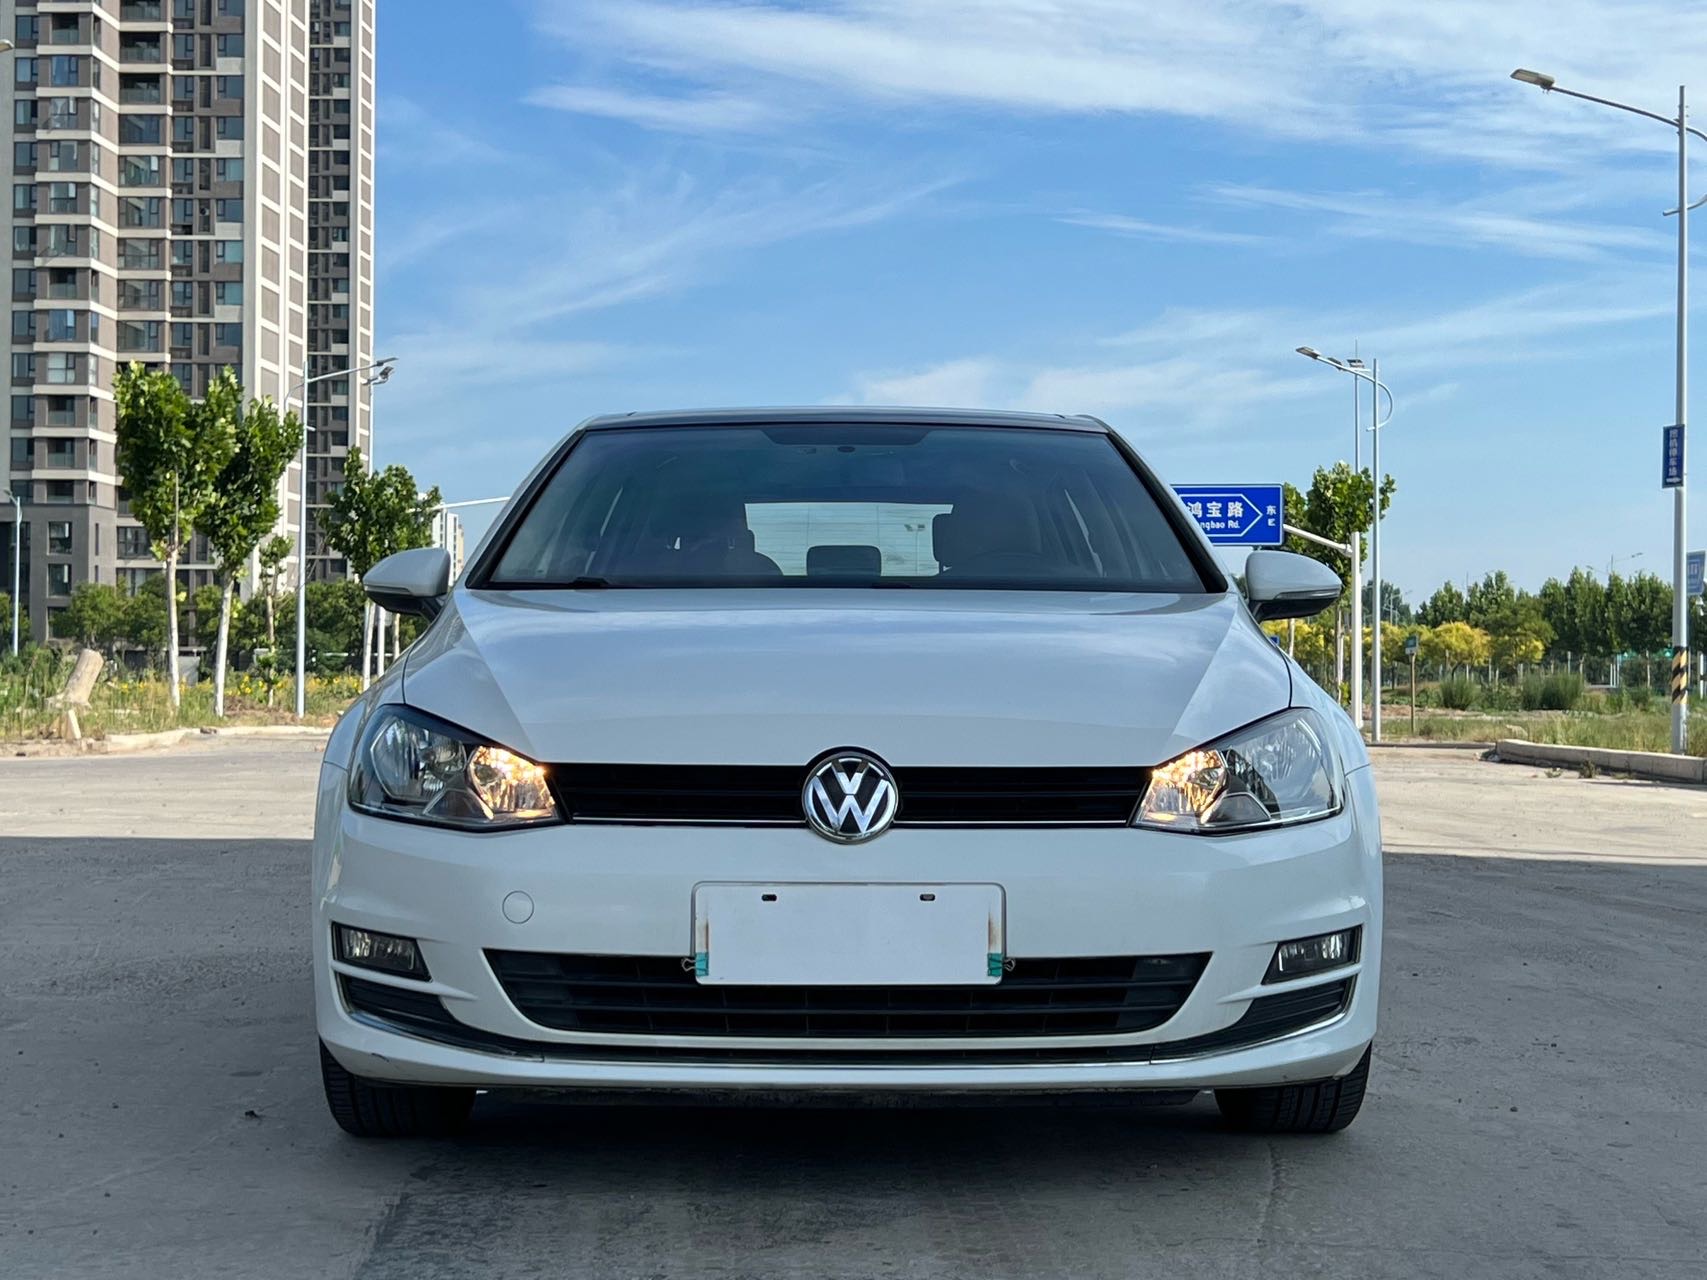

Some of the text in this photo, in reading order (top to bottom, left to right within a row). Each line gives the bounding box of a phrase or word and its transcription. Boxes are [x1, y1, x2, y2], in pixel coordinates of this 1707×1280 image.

[1186, 501, 1243, 518] 鸿宝路
[1266, 505, 1276, 515] 东
[1200, 520, 1240, 531] ngbao Rd.
